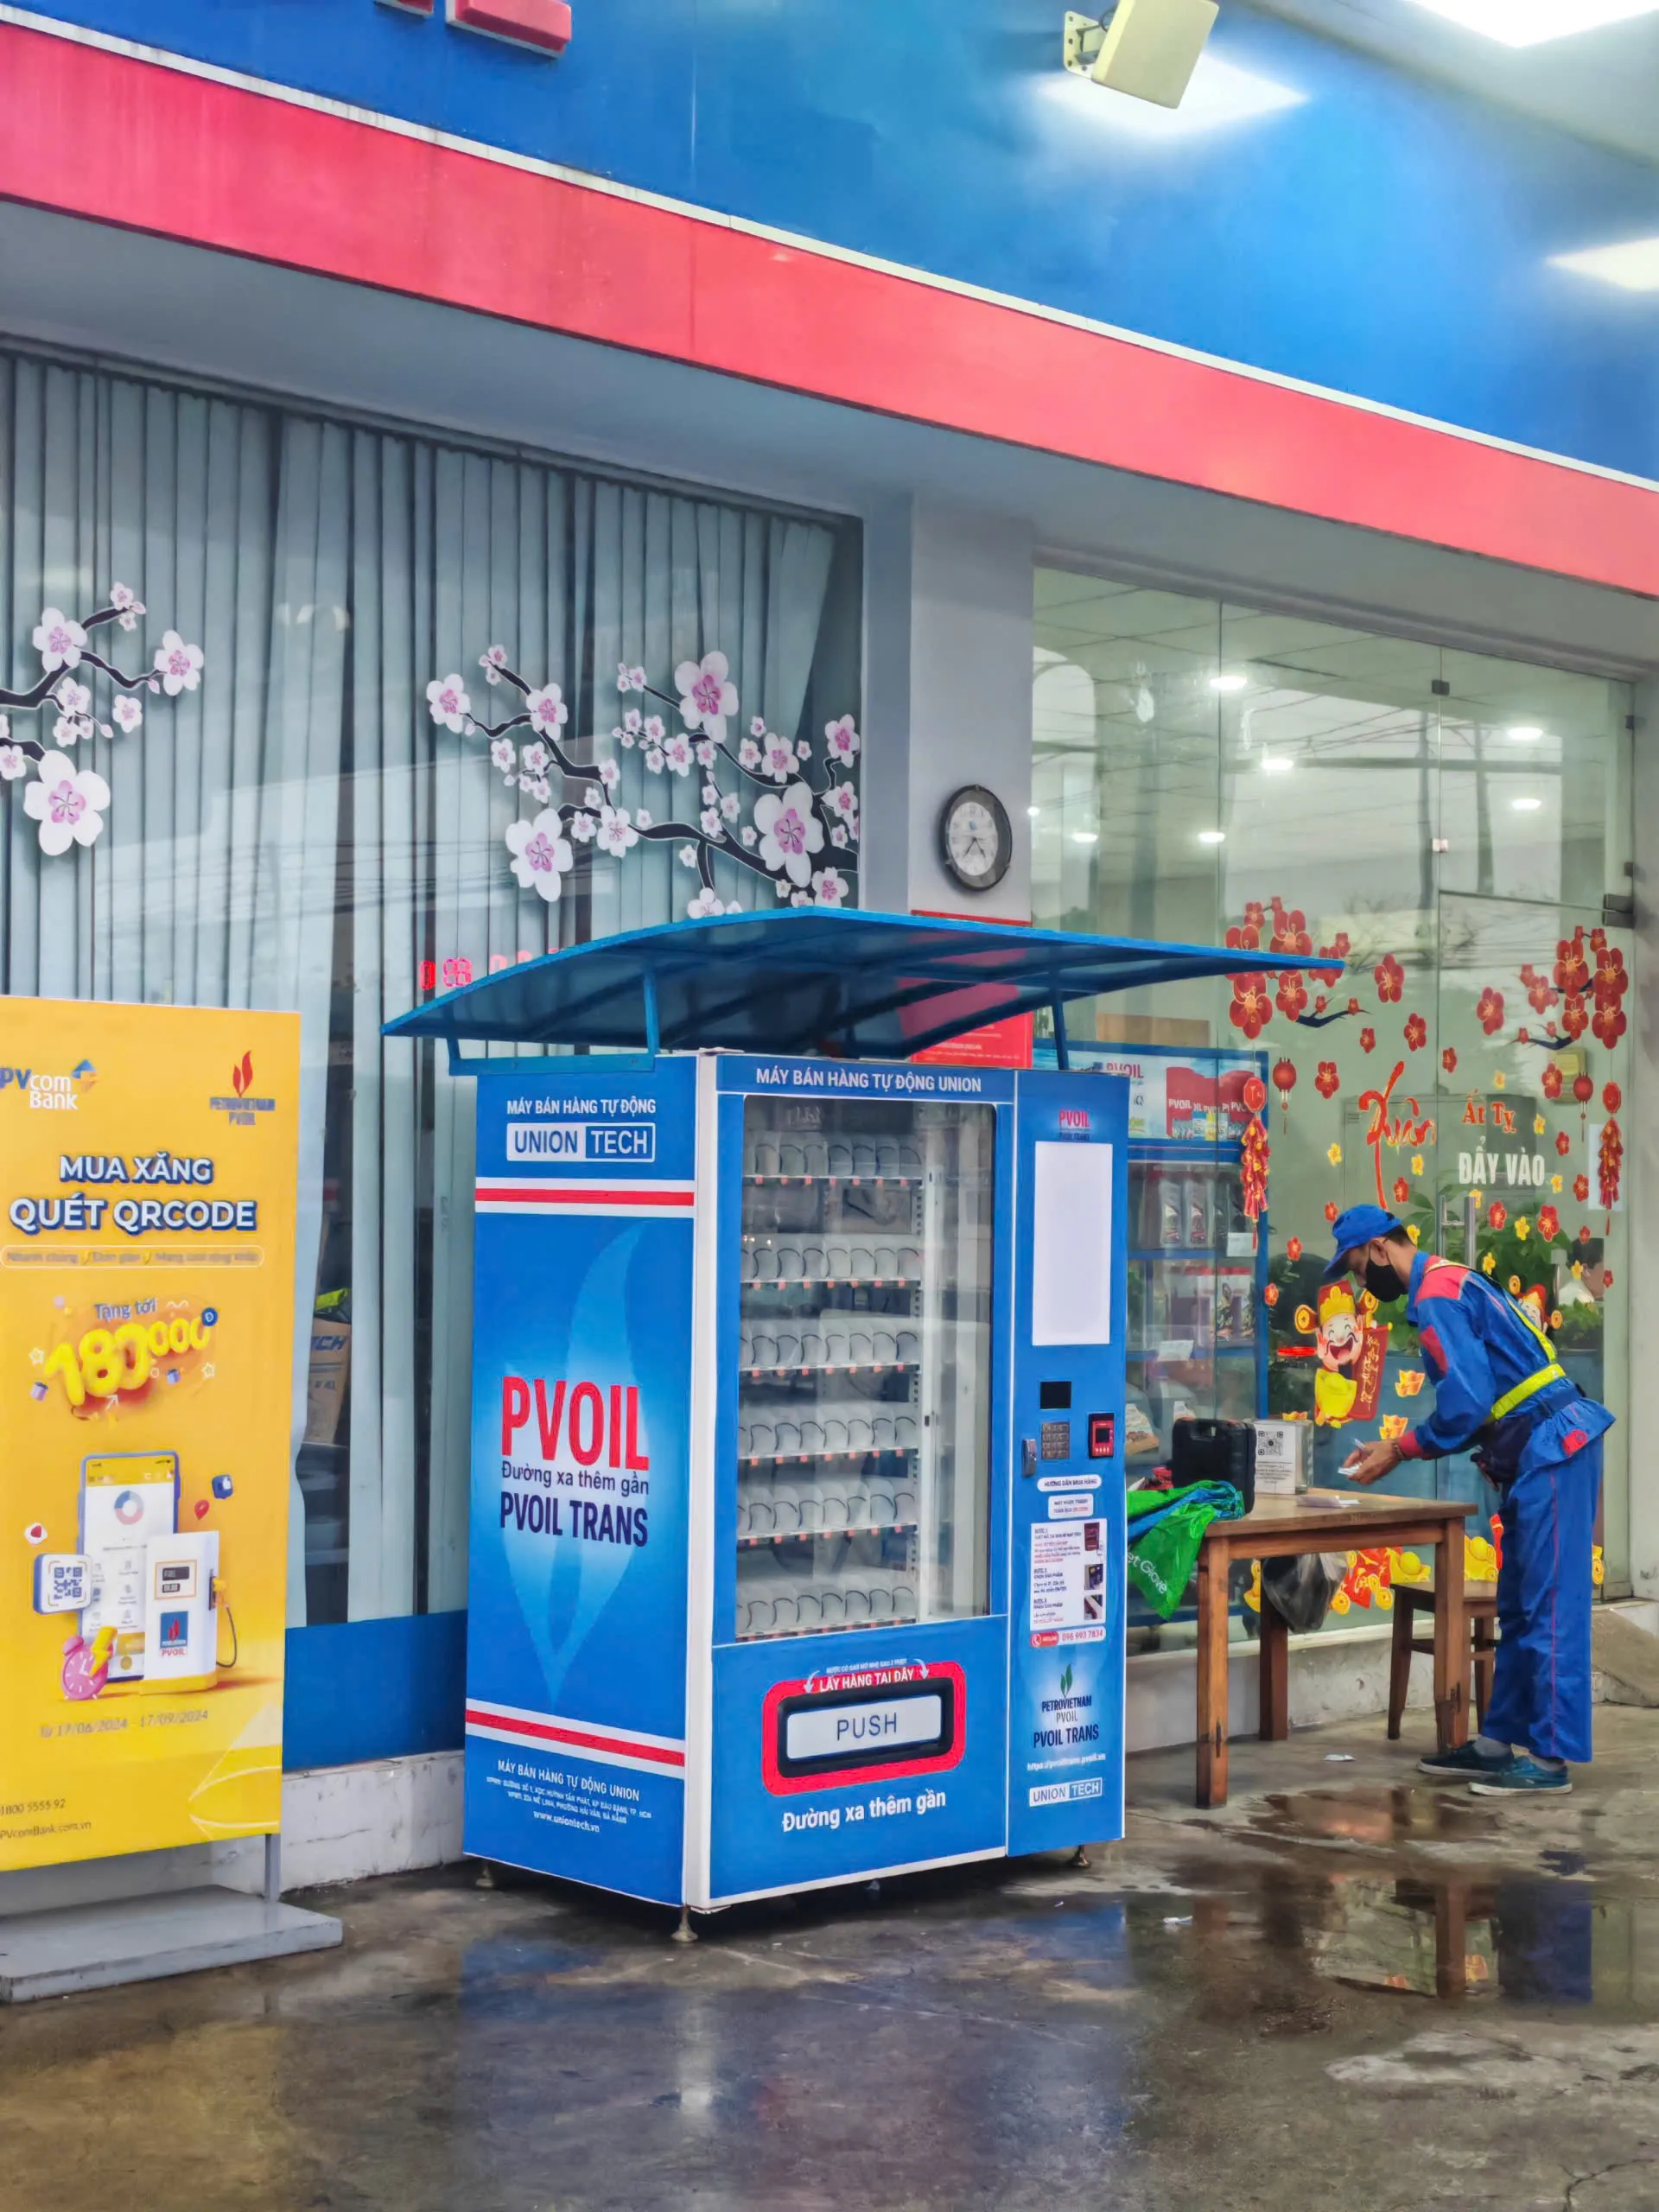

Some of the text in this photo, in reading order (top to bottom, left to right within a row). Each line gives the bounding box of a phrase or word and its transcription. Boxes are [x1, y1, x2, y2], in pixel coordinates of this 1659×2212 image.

[756, 1065, 982, 1093] MÁY BÁN HÀNG TỰ ĐỘNG UNION
[29, 1090, 79, 1109] Bank
[507, 1096, 657, 1117] MÁY BÁN HÀNG TỰ ĐỘNG
[1058, 1109, 1090, 1128] PVOIL
[514, 1130, 648, 1154] UNION TECH
[59, 1151, 214, 1184] MUA XĂNG
[1459, 1136, 1545, 1186] ĐẨY VÀO
[9, 1192, 257, 1236] QUÉT QRCODE
[94, 1298, 158, 1322] Tặng tới
[501, 1376, 650, 1471] PVOIL
[502, 1460, 650, 1497] Đường xa thêm gần
[500, 1491, 648, 1548] PVOIL TRANS
[842, 1673, 872, 1689] HÀNG
[1041, 1695, 1092, 1713] PETROVIETNAM
[1056, 1710, 1078, 1724] PVOIL
[836, 1713, 897, 1740] PUSH
[1033, 1724, 1100, 1749] PVOIL TRANS
[498, 1758, 516, 1773] MÁY
[518, 1763, 537, 1779] BÁN
[538, 1767, 564, 1785] HÀNG
[609, 1783, 639, 1802] UNION
[1033, 1781, 1100, 1803] UNION TECH
[782, 1789, 946, 1833] Đường xa thêm gần
